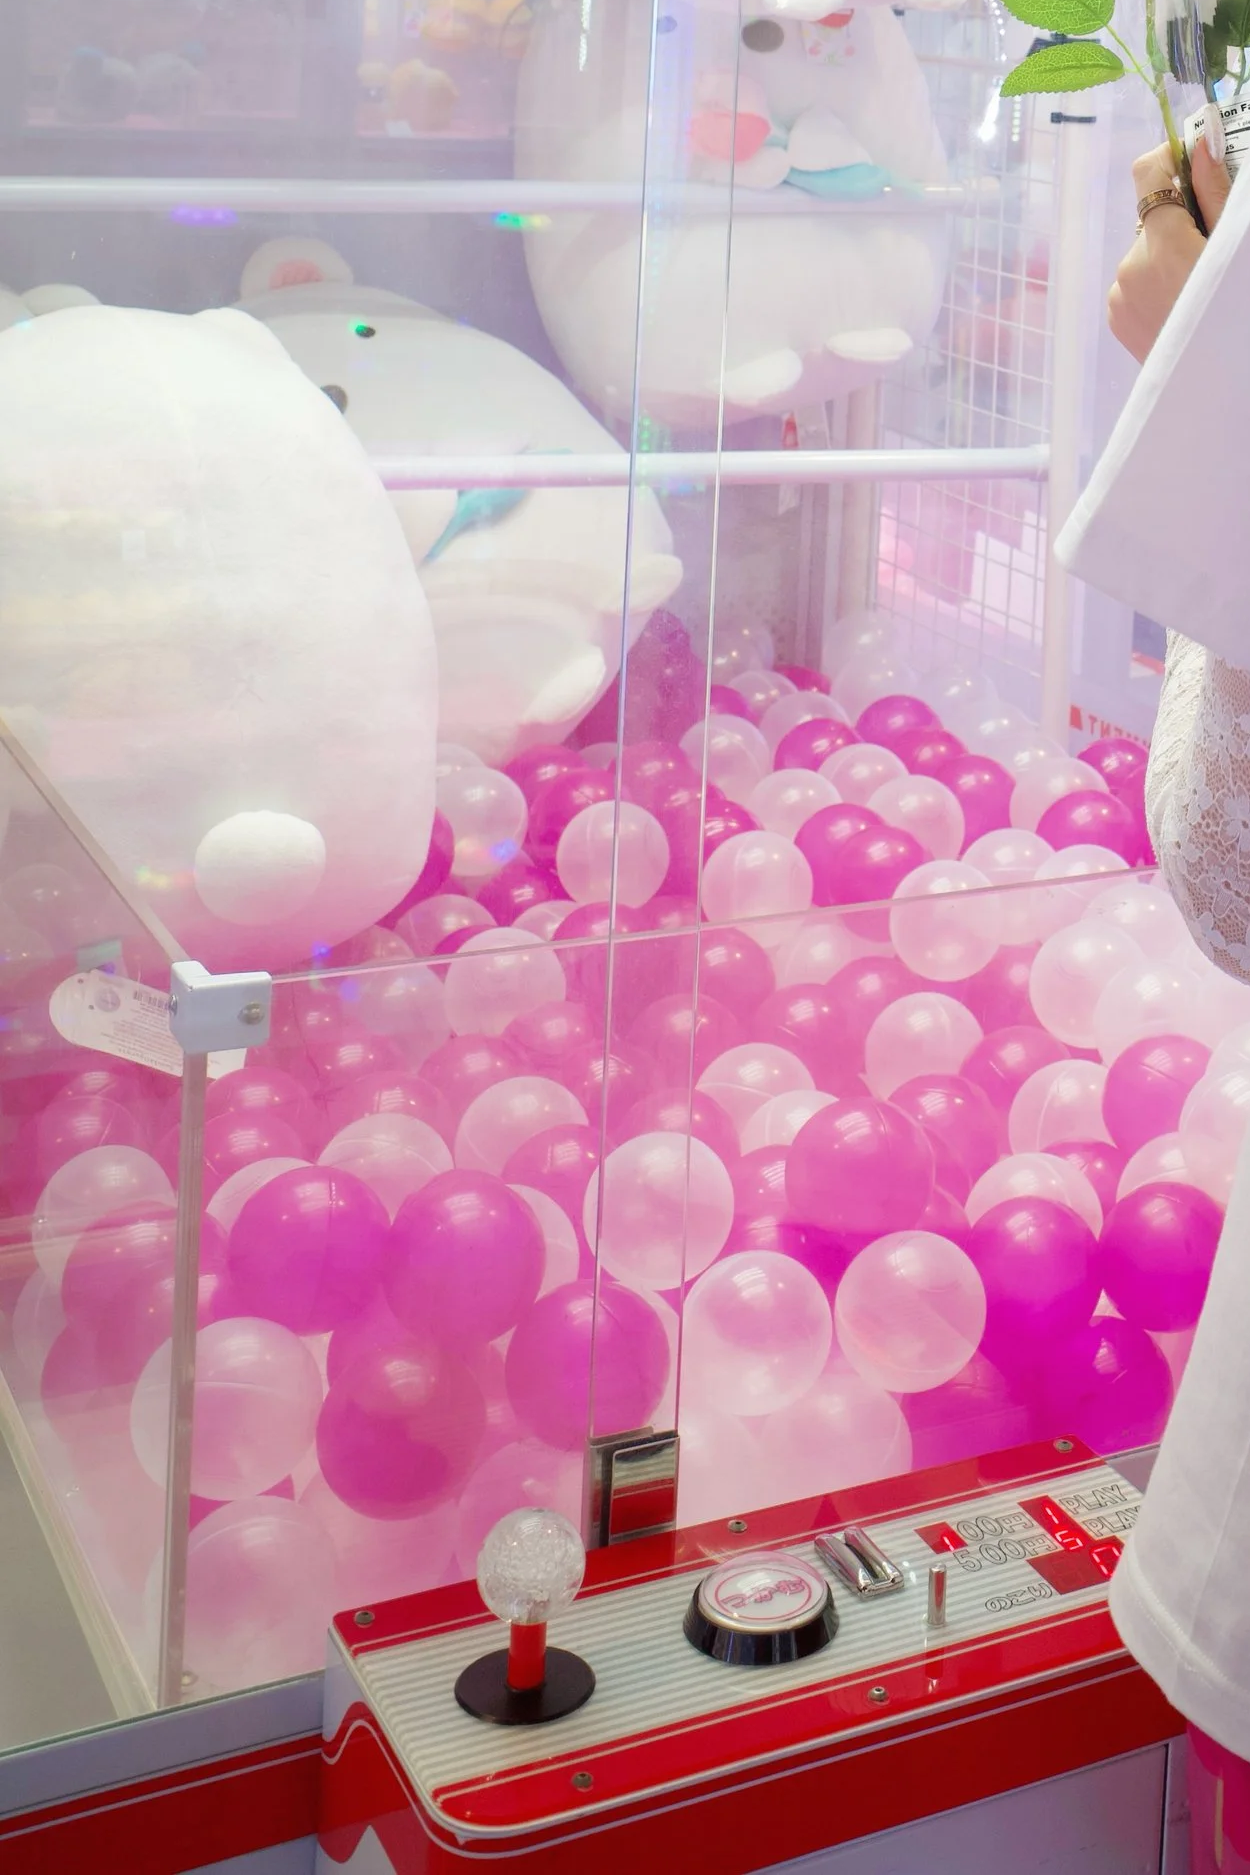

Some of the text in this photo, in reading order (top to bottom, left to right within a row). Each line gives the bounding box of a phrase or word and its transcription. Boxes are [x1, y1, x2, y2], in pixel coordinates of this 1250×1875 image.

[1194, 109, 1238, 130] Nuion
[1058, 1483, 1129, 1515] PLAY
[953, 1533, 1059, 1572] 500円
